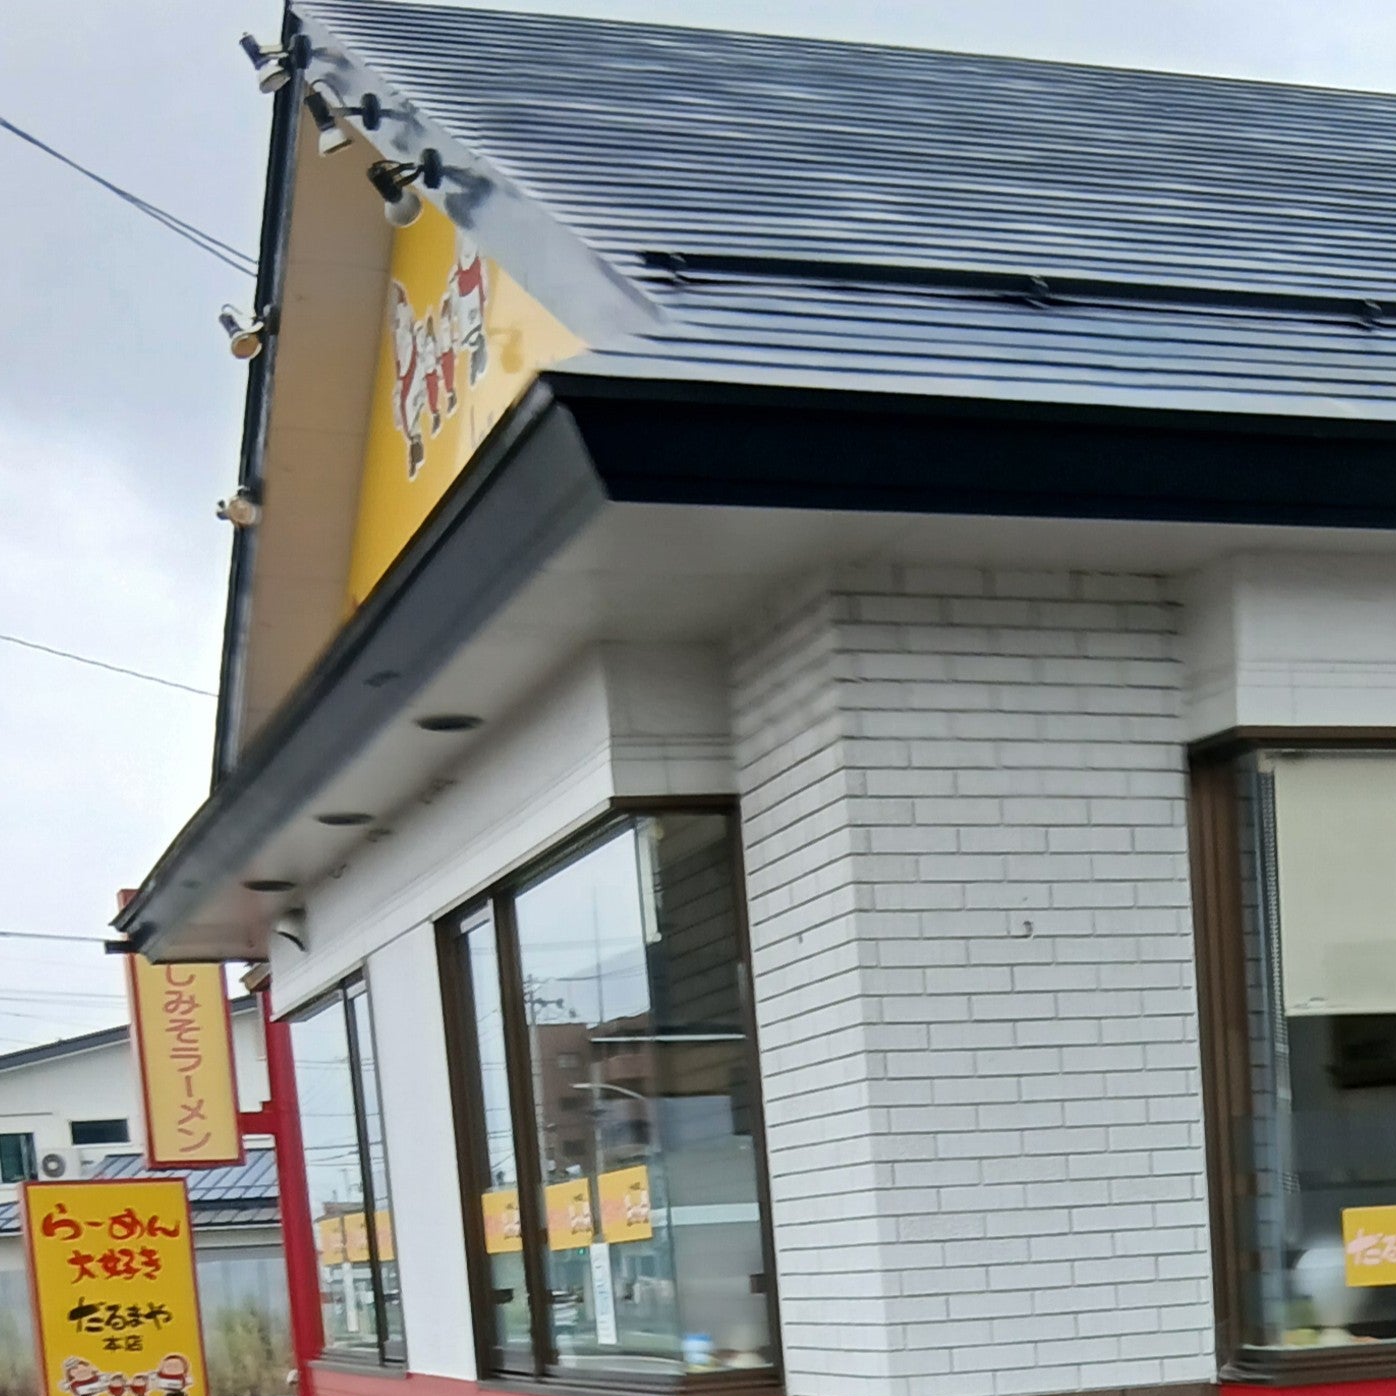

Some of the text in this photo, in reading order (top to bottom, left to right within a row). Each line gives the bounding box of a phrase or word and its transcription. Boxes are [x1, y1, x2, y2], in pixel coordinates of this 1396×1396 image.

[42, 1202, 181, 1241] らーめん
[67, 1246, 162, 1284] 大好き
[102, 1335, 143, 1352] 本店
